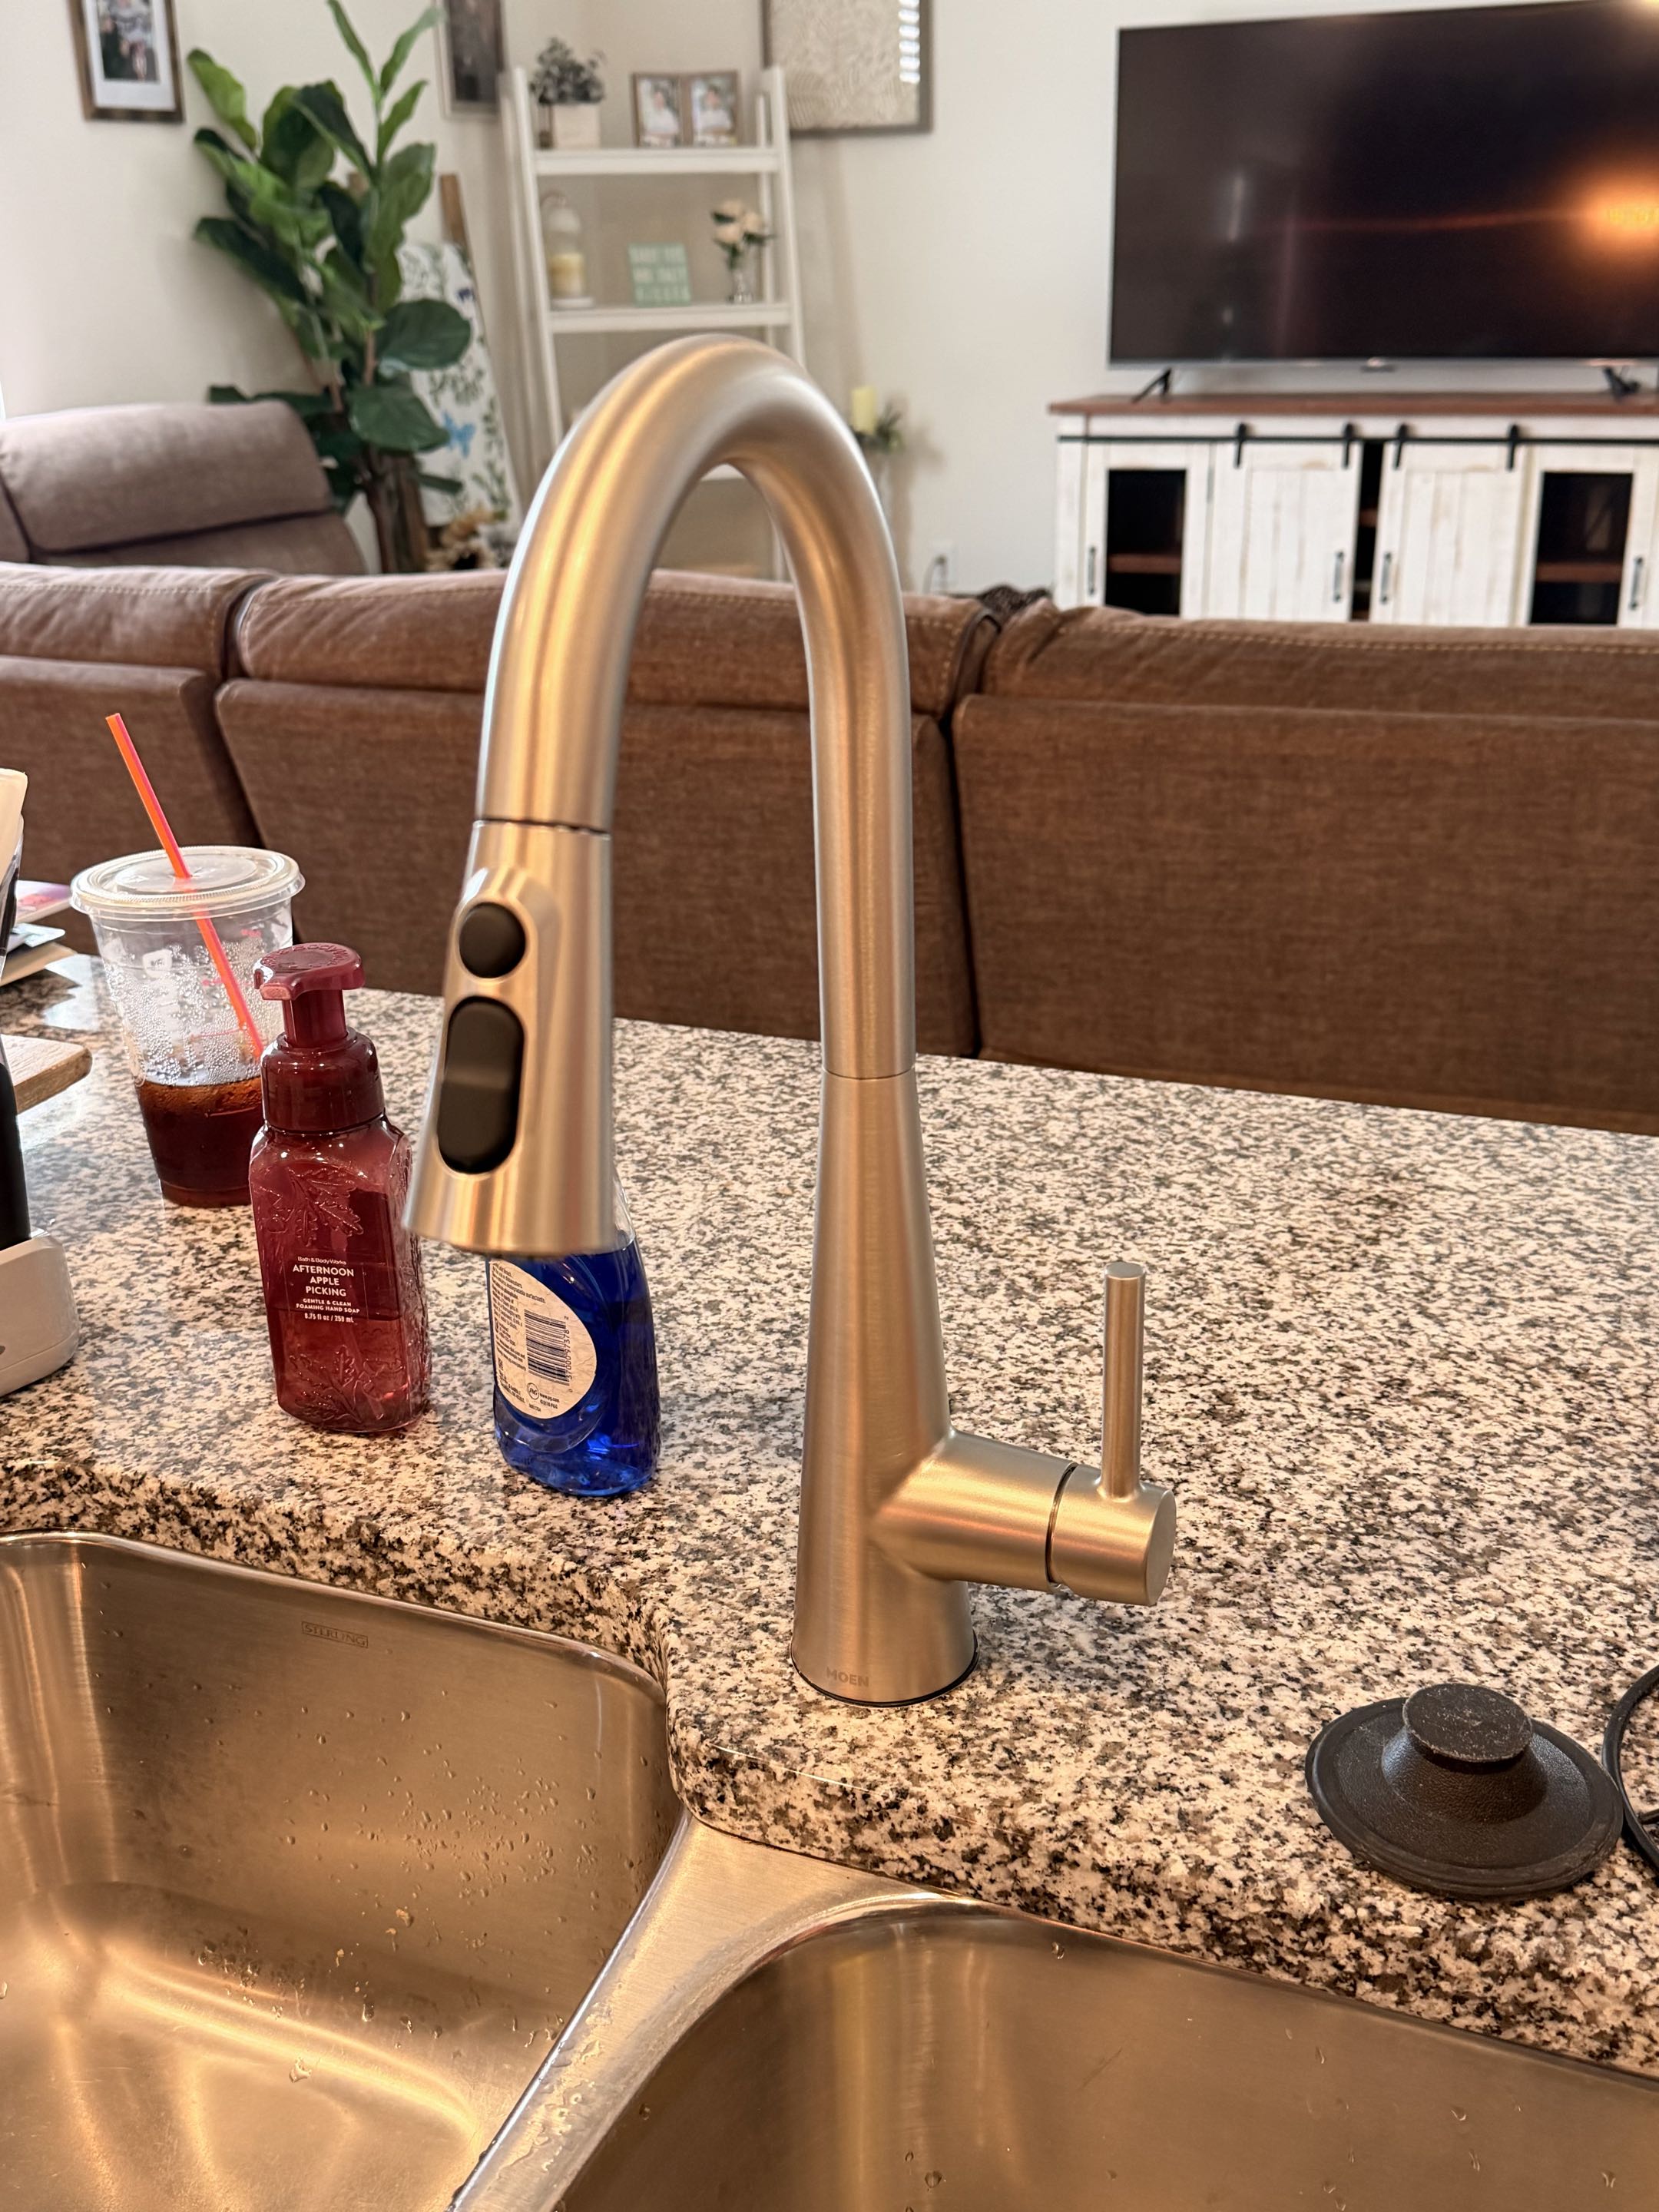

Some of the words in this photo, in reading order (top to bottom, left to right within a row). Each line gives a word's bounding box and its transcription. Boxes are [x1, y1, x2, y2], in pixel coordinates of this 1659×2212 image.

[293, 1264, 354, 1277] AFTERNOON
[310, 1276, 339, 1286] APPLE
[306, 1286, 346, 1296] PICKING
[826, 1666, 869, 1687] MOEN
